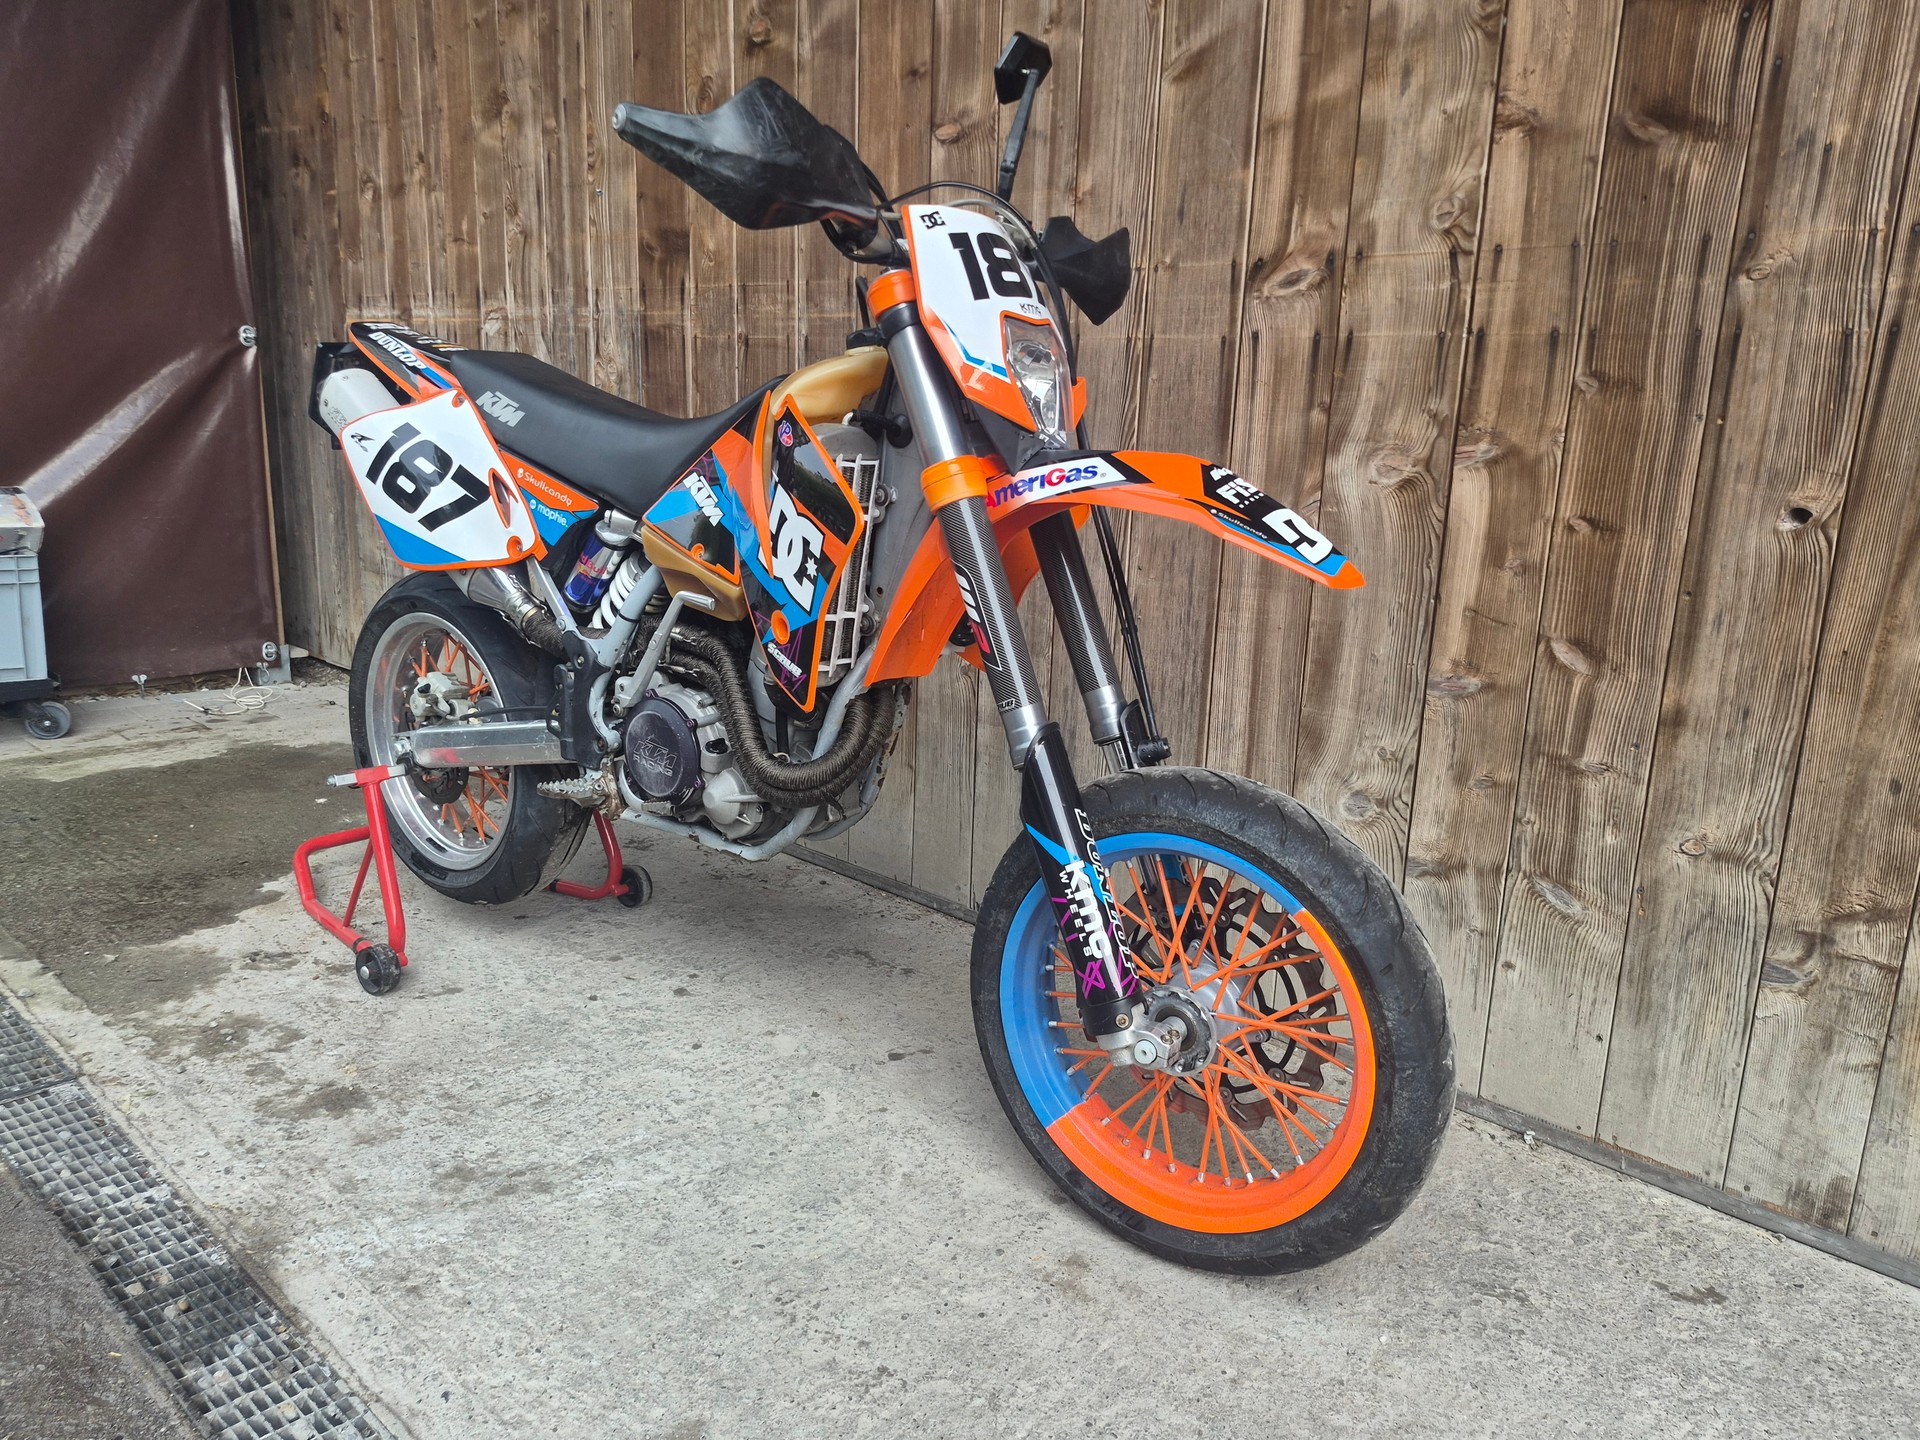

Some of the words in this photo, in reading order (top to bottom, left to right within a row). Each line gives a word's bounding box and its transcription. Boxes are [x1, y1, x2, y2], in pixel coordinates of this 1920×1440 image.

[919, 211, 946, 230] DC
[948, 232, 1046, 306] 18
[368, 331, 427, 369] DUNLOP
[476, 391, 526, 427] KTM
[365, 422, 493, 533] 187
[524, 472, 573, 506] Skullcandy
[683, 472, 725, 527] KTM
[757, 484, 824, 613] DC
[633, 737, 677, 769] KTM
[1058, 870, 1092, 957] WHEELS
[1064, 859, 1112, 960] kmc
